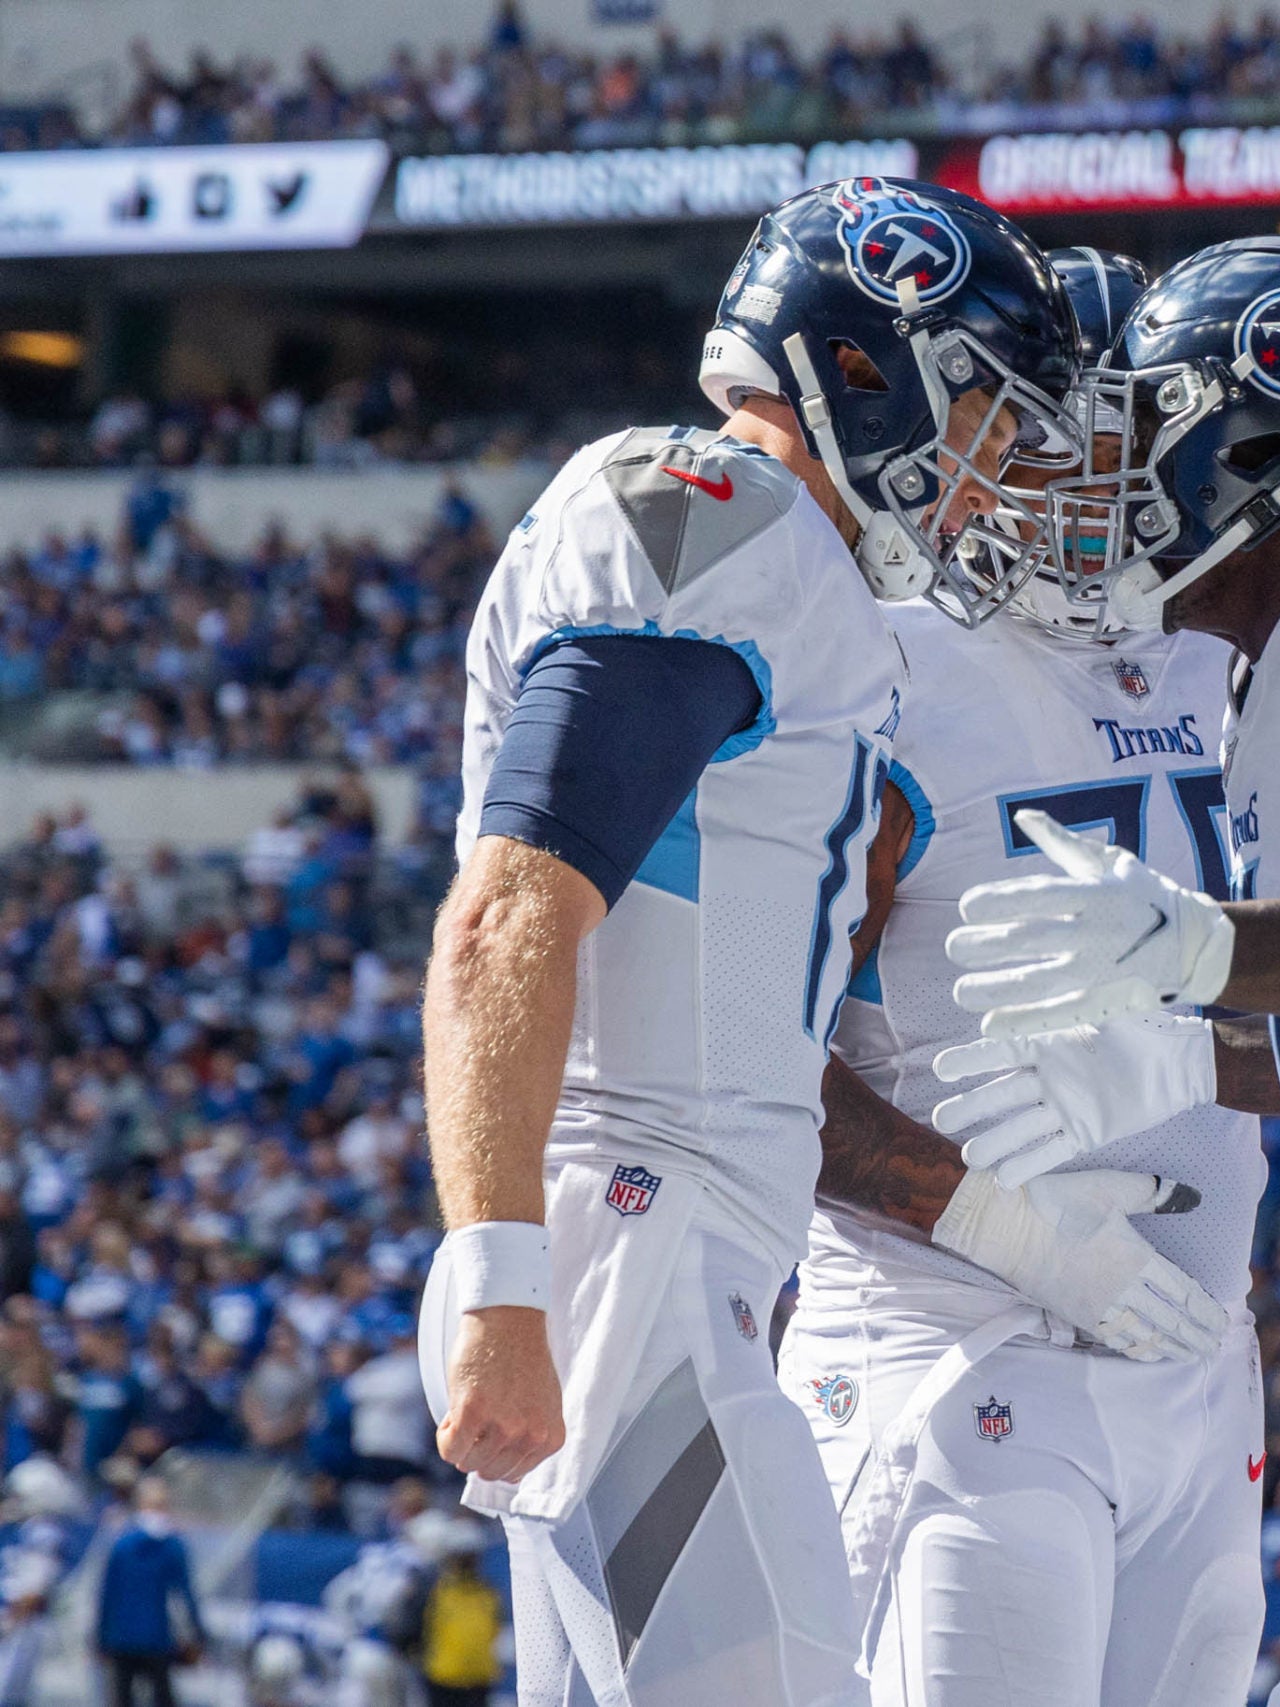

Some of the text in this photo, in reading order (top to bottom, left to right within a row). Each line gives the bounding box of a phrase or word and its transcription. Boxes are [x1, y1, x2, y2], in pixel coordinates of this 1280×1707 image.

[396, 139, 917, 224] METHODISTSPORTSCOM
[978, 129, 1178, 204] OFFICIAL
[1092, 713, 1204, 763] TITANS
[608, 1181, 648, 1211] NFL
[981, 1417, 1010, 1436] NFL
